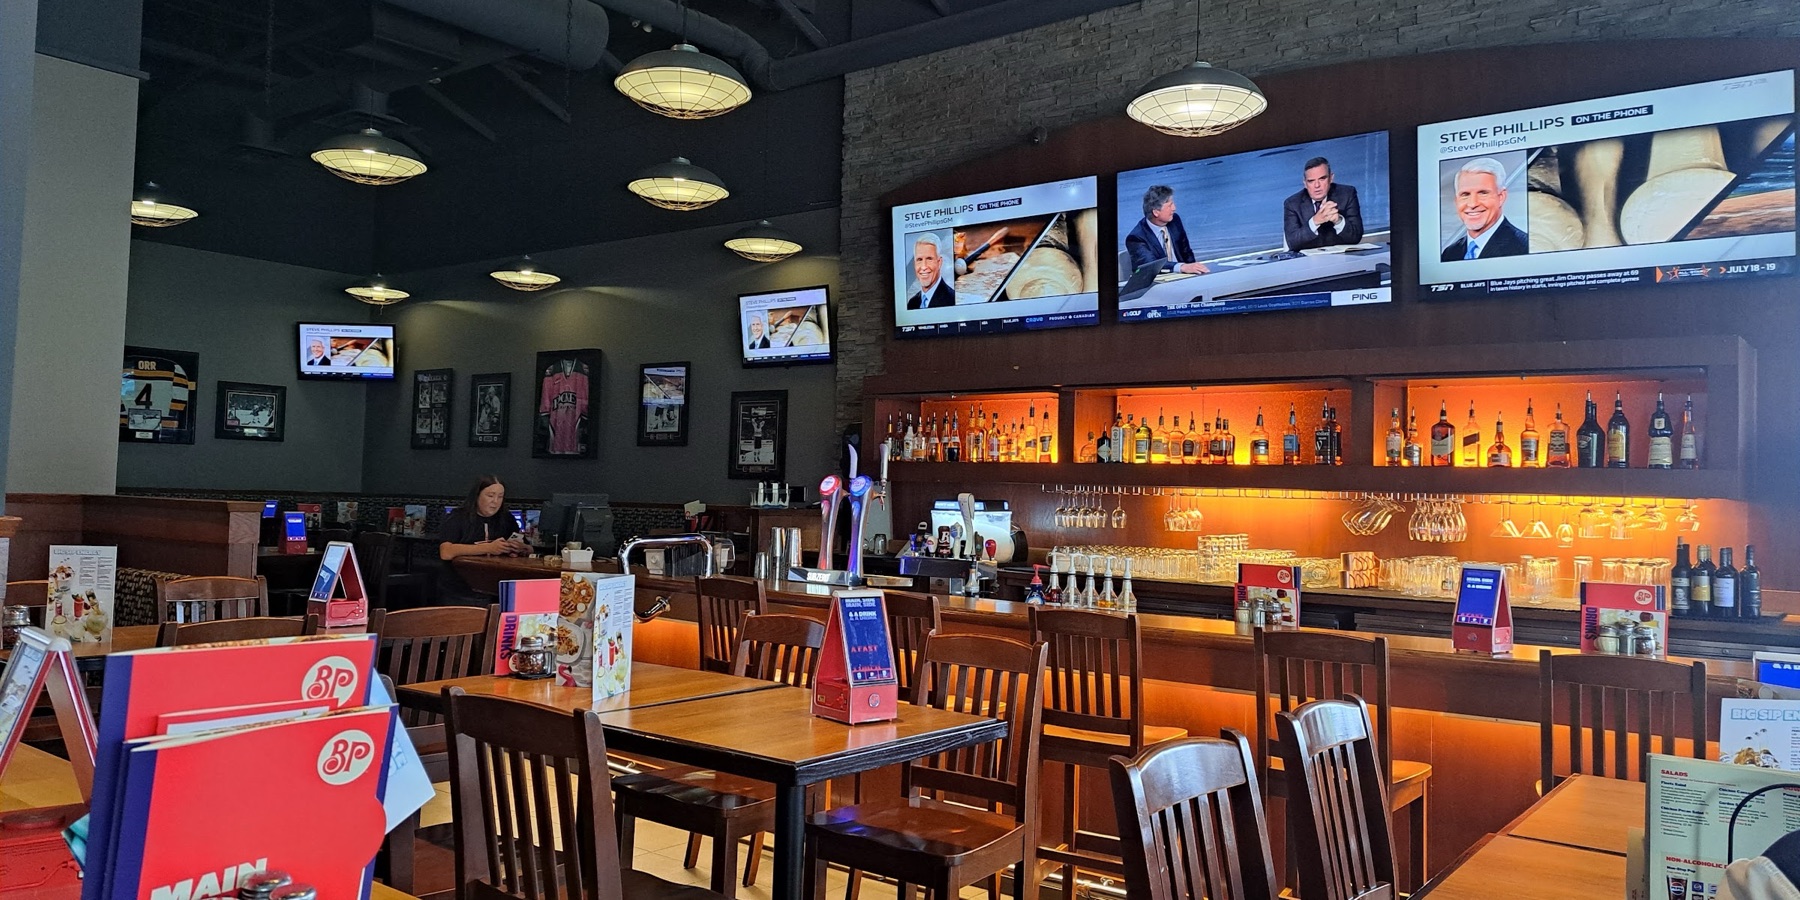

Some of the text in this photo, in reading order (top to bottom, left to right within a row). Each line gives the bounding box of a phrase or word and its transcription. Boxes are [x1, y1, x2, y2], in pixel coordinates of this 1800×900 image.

[1440, 107, 1648, 144] STEVE PHILLIPS ON THE PHONE
[1440, 136, 1527, 154] @StevePhillipsGM
[904, 210, 932, 221] STEVE
[934, 204, 974, 217] PHILLIPS
[1000, 199, 1019, 207] PHONE
[905, 218, 953, 229] @StevePhillipsGM
[1726, 265, 1748, 274] JULY
[1751, 264, 1759, 272] 18
[1430, 284, 1454, 292] TSN
[1516, 277, 1539, 285] pitching
[1352, 292, 1377, 301] PING
[138, 361, 156, 370] ORR
[134, 383, 152, 409] 4
[1585, 607, 1598, 640] DRINKS
[500, 615, 517, 660] DRINKS
[306, 665, 354, 700] BP
[1731, 708, 1756, 720] BIG
[1757, 709, 1782, 721] SIP
[323, 737, 375, 775] BP
[1661, 769, 1688, 777] SALADS
[1666, 856, 1722, 869] NON-ALCOHOLIC
[151, 858, 267, 900] MAIN
